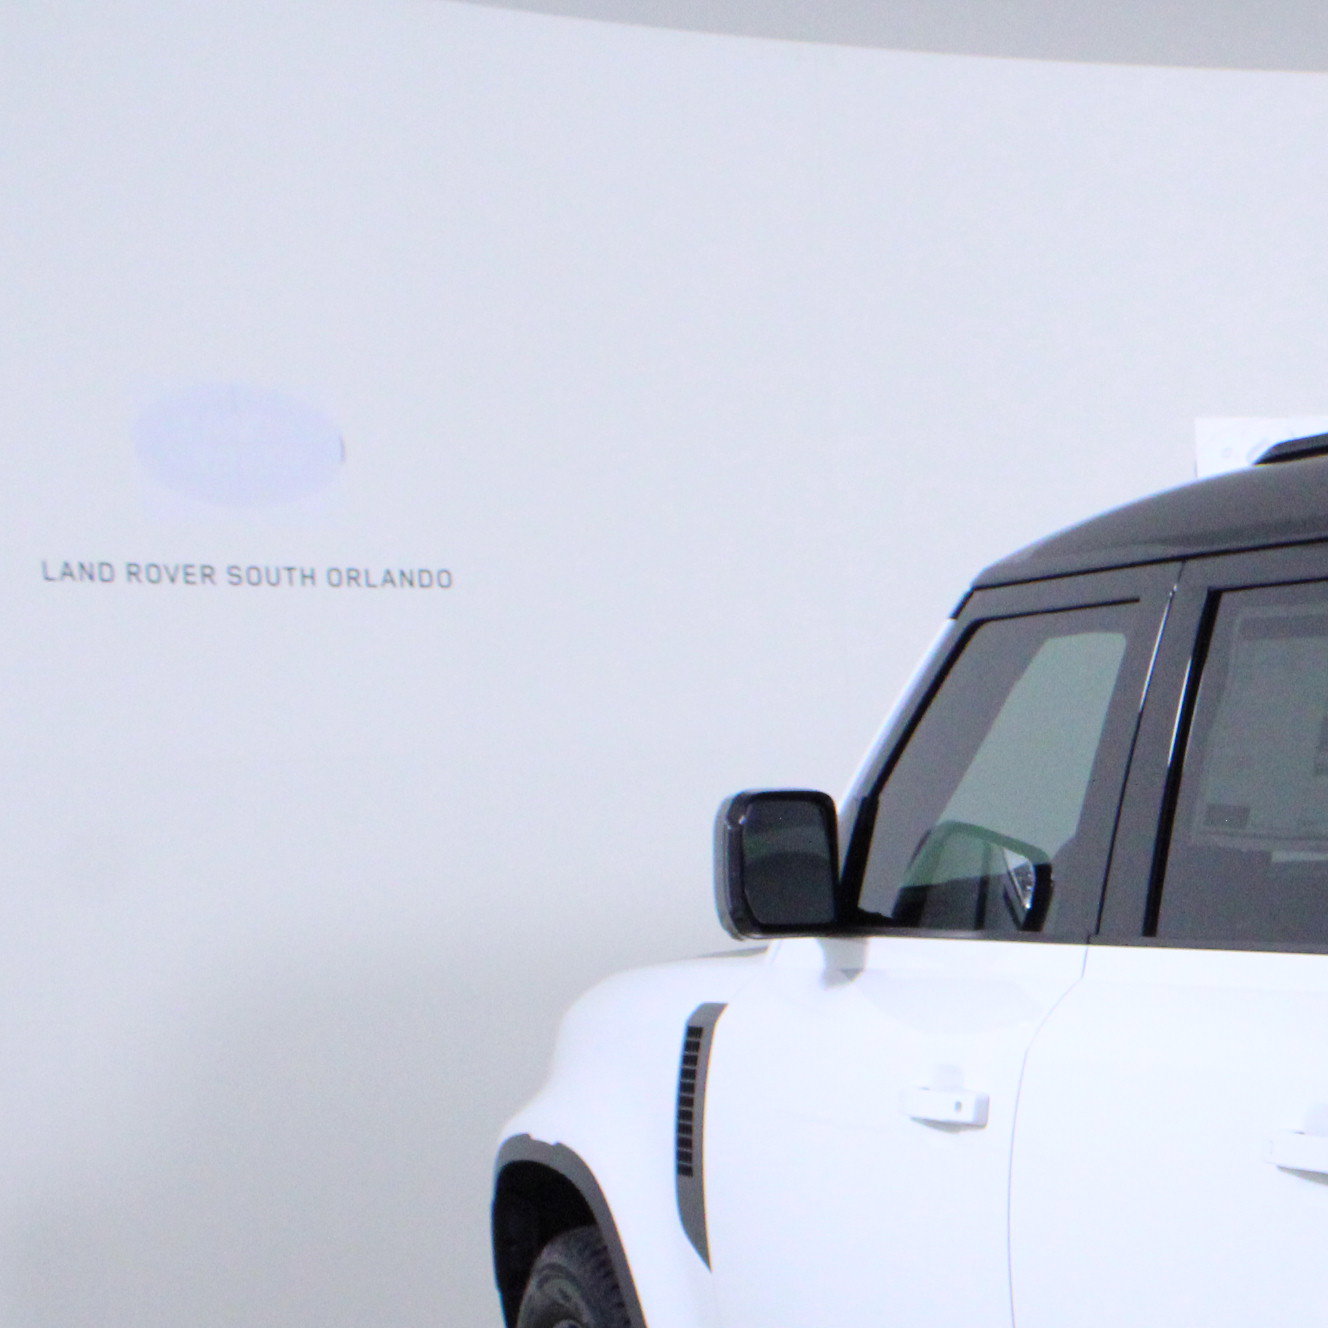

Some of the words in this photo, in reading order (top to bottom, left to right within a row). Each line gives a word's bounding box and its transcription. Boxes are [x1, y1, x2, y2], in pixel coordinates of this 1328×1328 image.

[41, 560, 116, 584] LAND
[125, 561, 216, 586] ROVER
[226, 564, 317, 588] SOUTH
[326, 566, 453, 590] ORLANDO
